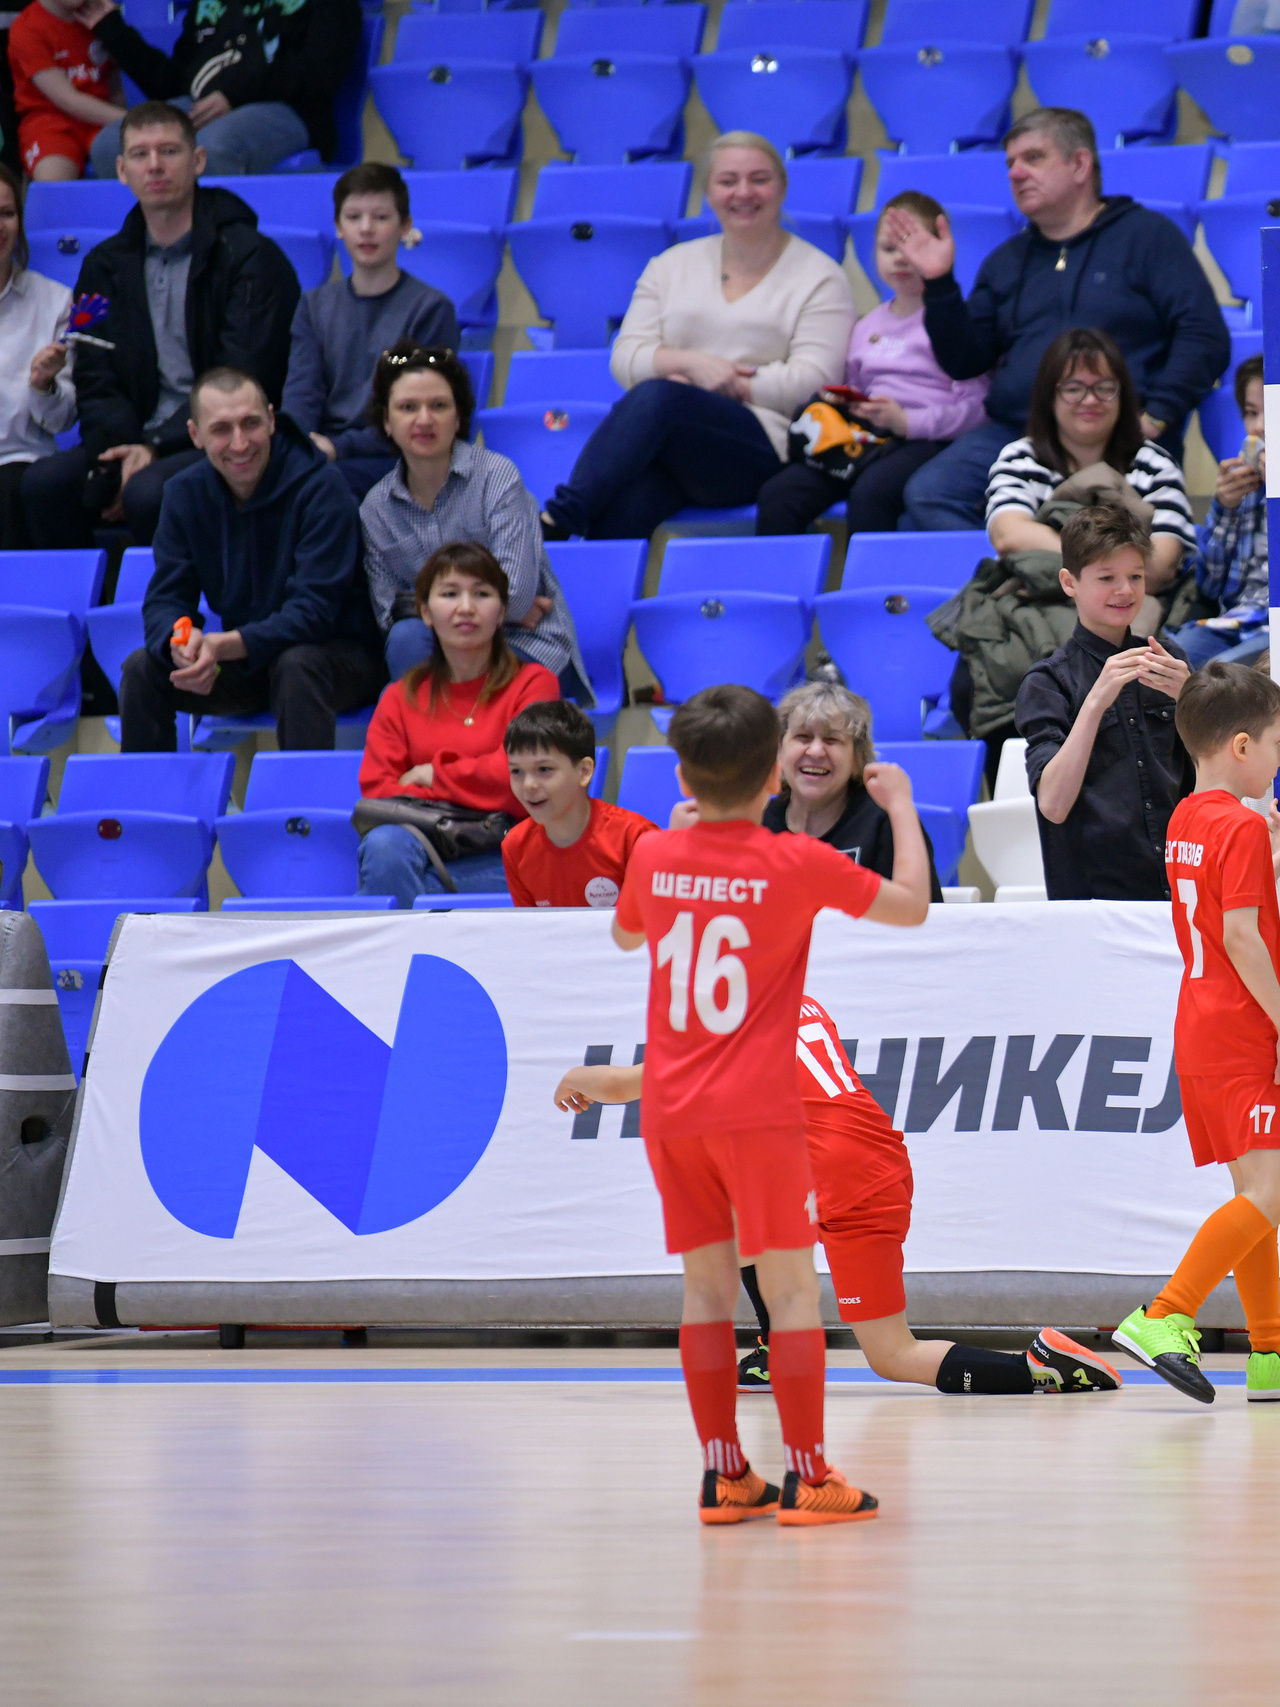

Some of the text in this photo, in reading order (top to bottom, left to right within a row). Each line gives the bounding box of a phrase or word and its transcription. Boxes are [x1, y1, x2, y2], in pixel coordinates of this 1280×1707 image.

[651, 871, 769, 904] ШЕЛЕСТ
[656, 911, 751, 1035] 16
[796, 1022, 857, 1098] 17
[1249, 1104, 1276, 1134] 17
